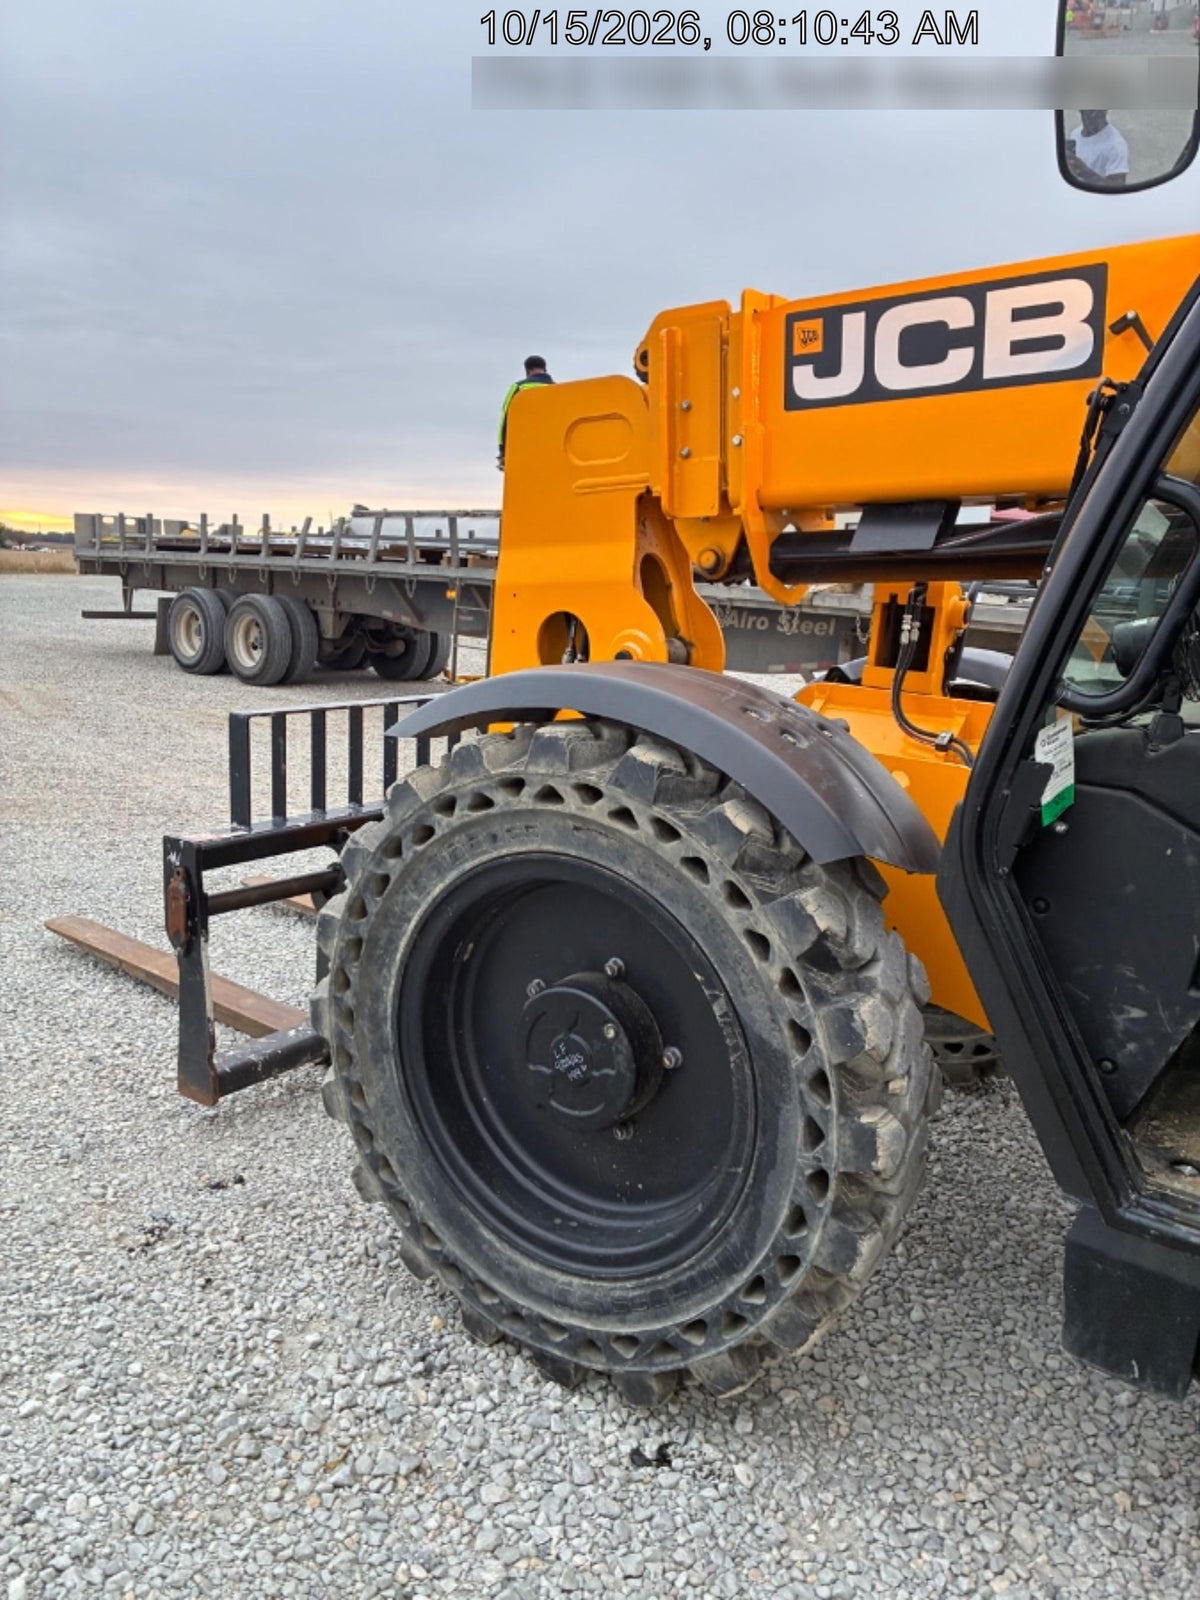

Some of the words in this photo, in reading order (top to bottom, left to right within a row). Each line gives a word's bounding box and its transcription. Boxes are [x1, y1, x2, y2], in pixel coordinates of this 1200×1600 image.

[792, 278, 1095, 401] JCB
[724, 610, 769, 630] Alro
[777, 611, 836, 636] Steel
